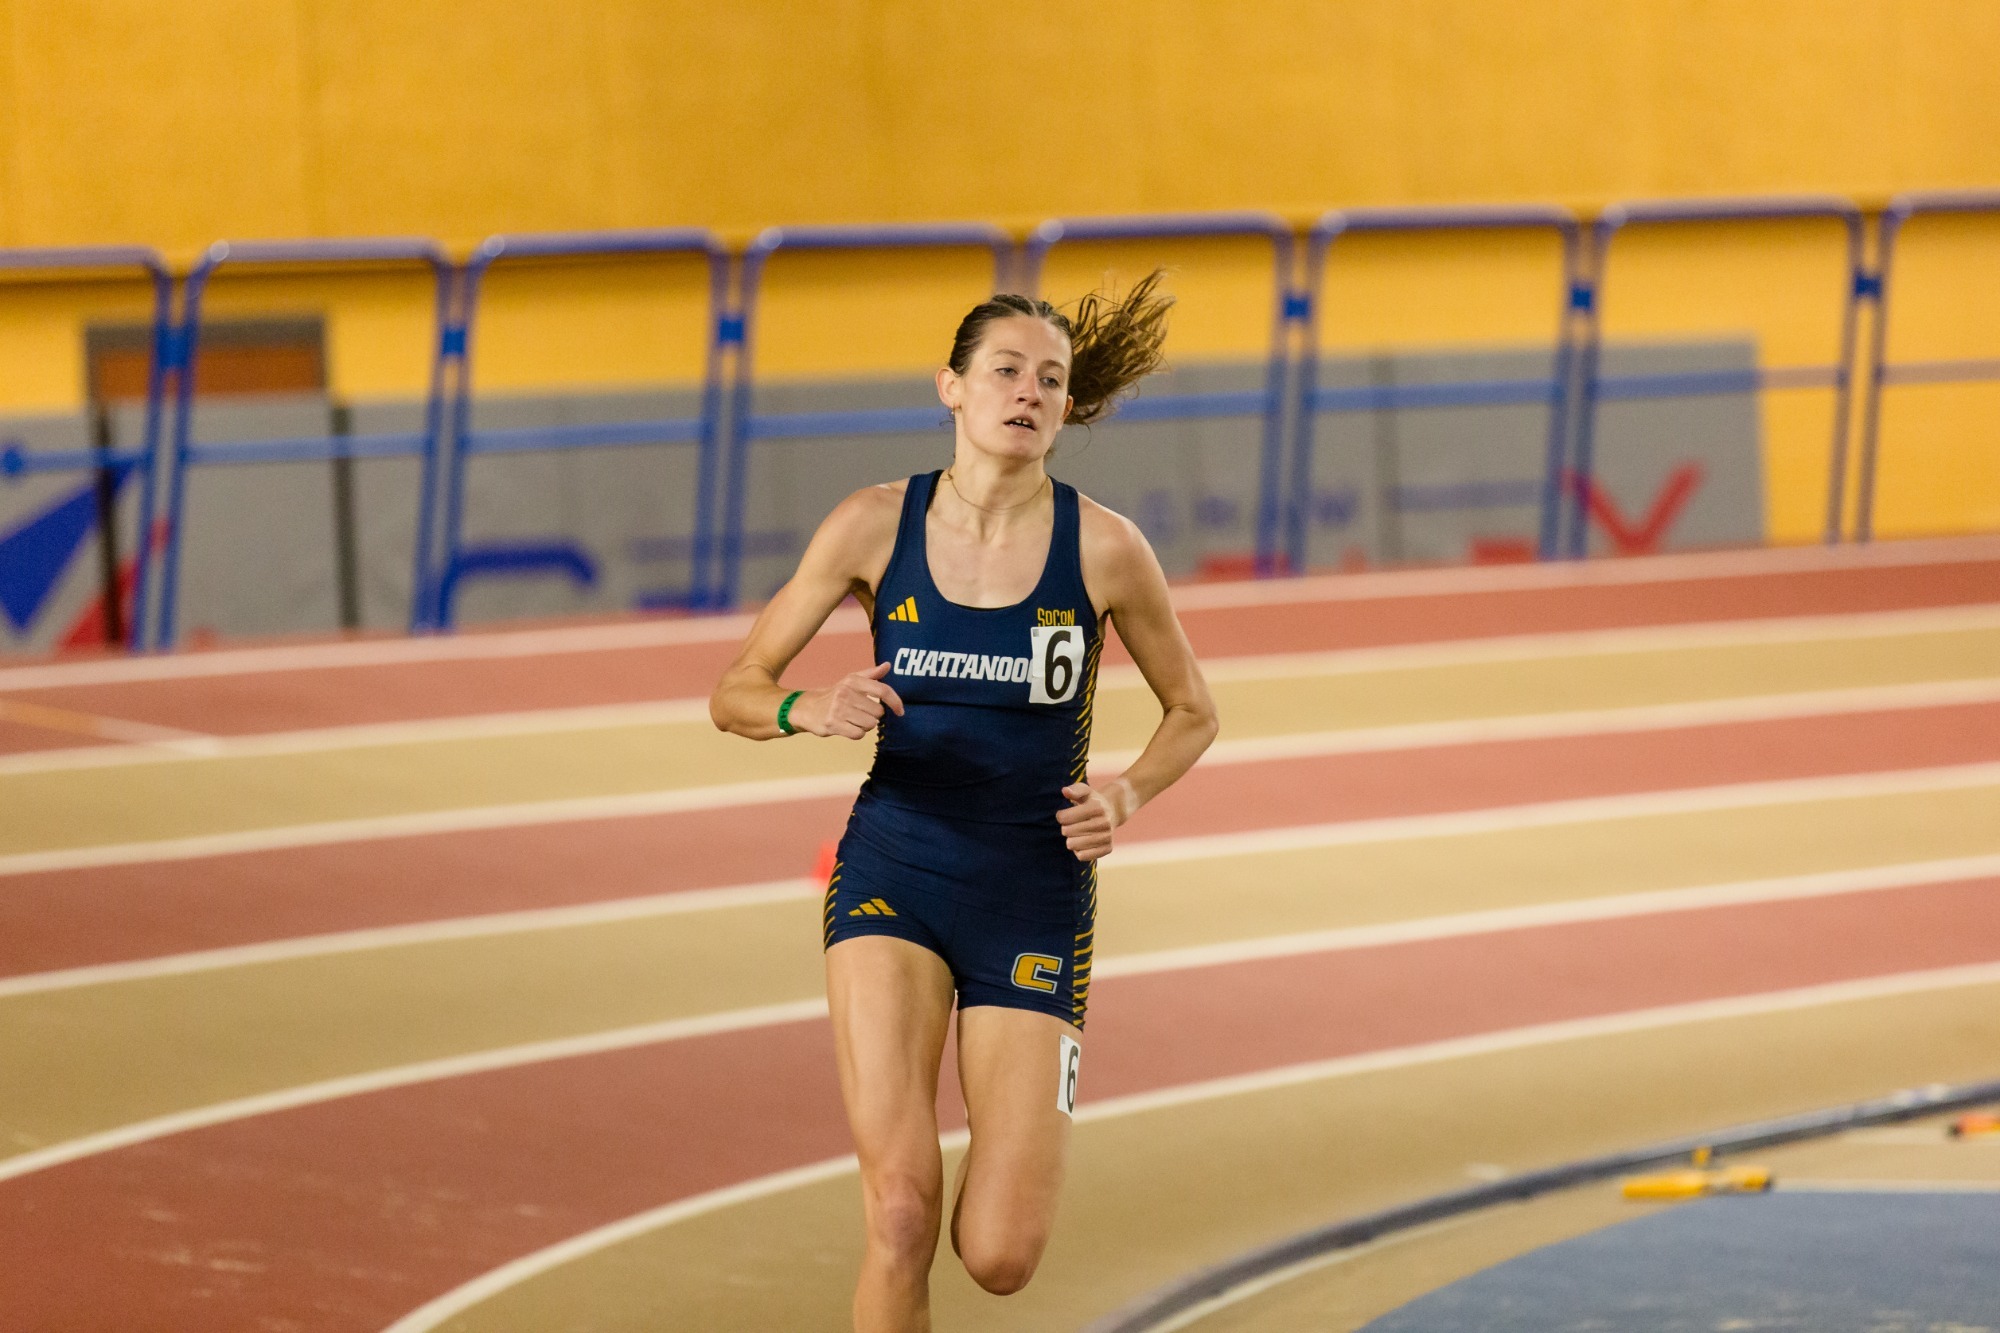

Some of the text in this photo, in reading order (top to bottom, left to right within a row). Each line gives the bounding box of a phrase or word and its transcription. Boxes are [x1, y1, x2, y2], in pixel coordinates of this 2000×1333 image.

[894, 647, 1033, 684] CHATTANOO
[1044, 630, 1073, 700] 6
[1011, 952, 1063, 995] C
[1066, 1044, 1079, 1114] 6
